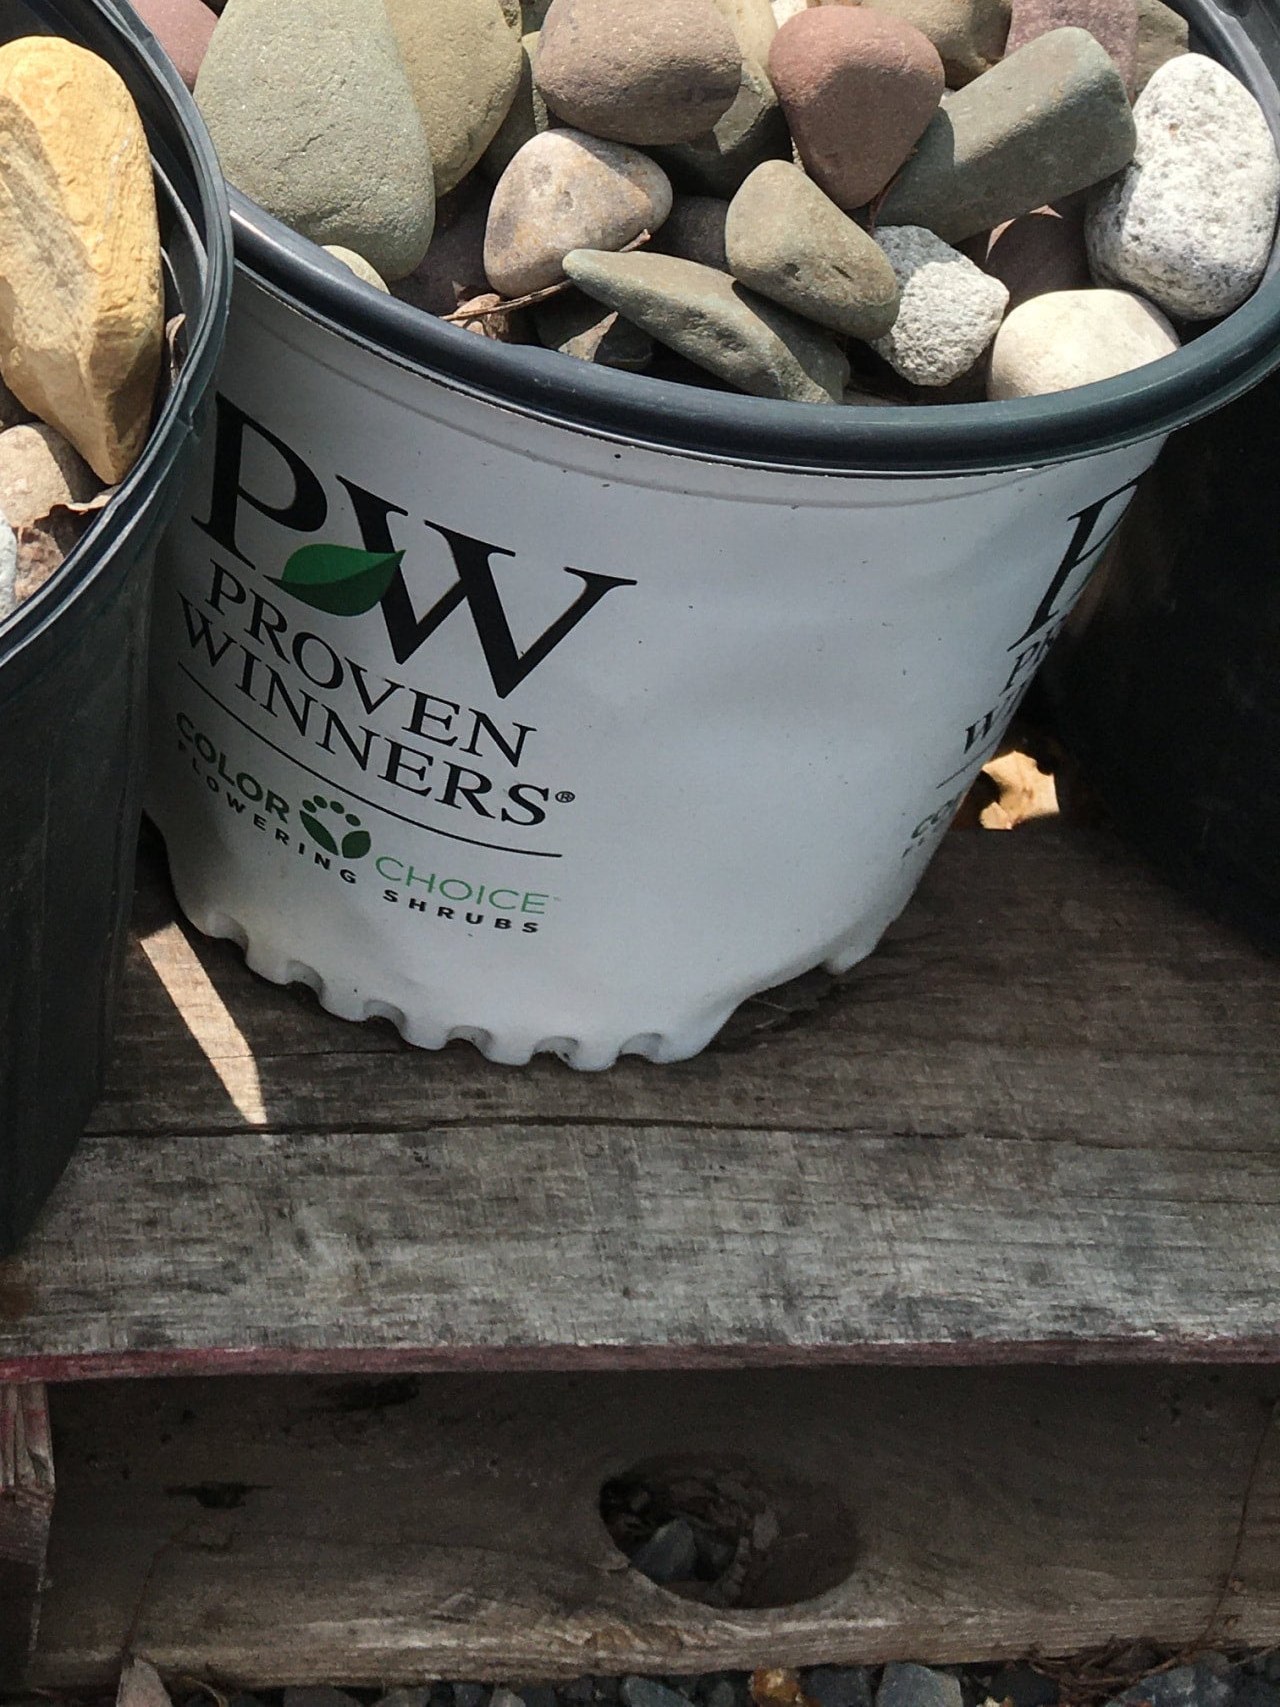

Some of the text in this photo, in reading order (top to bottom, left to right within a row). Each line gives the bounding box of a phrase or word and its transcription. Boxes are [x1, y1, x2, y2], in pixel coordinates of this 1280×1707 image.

[191, 390, 638, 700] PW
[204, 558, 537, 767] PROVEN
[176, 712, 290, 824] COLOR
[382, 889, 540, 933] SHRUBS
